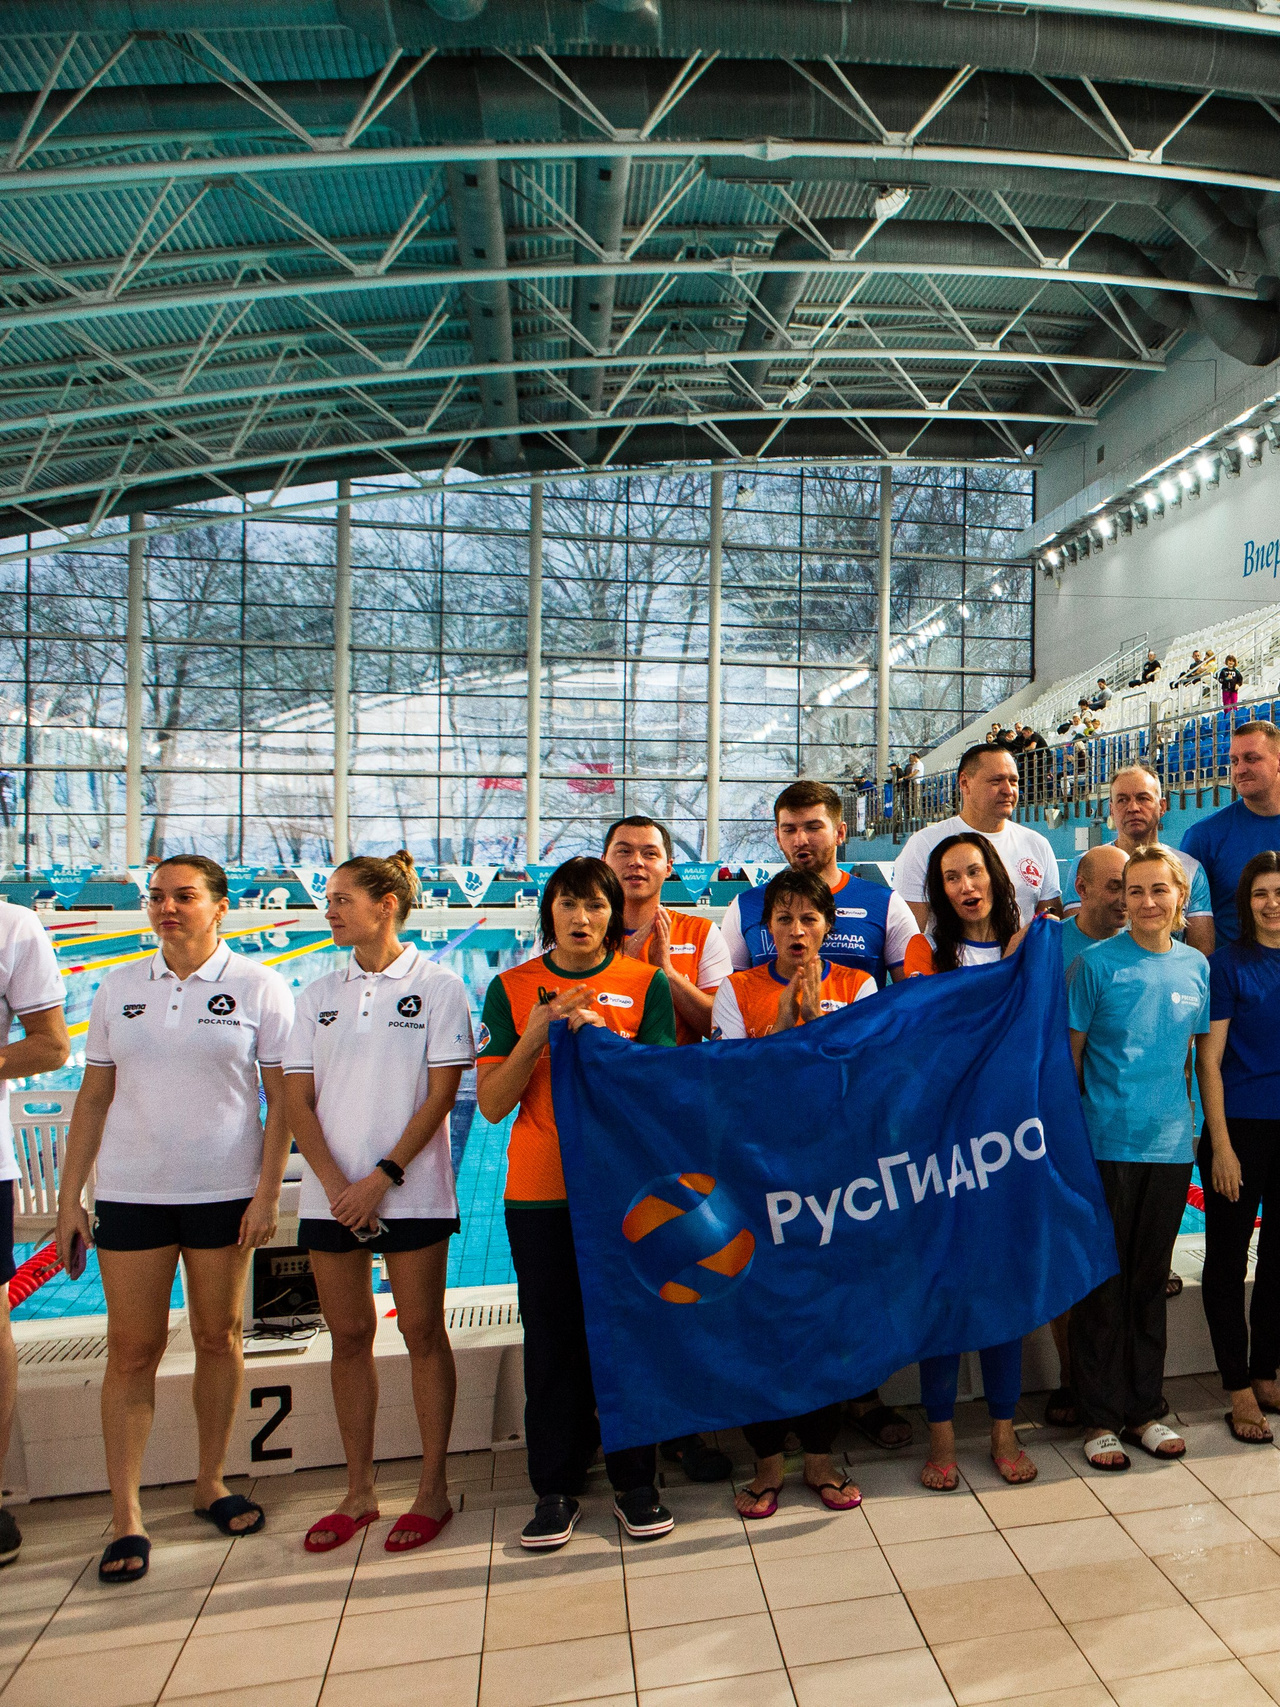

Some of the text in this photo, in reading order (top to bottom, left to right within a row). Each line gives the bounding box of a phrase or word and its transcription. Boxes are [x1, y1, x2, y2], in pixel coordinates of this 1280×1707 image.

[53, 868, 85, 877] MAD
[50, 876, 85, 885] WAVE
[826, 933, 865, 943] КИАДА
[123, 1003, 147, 1011] arena
[318, 1010, 339, 1018] arena
[197, 1018, 241, 1026] РОСАТОМ
[388, 1021, 426, 1030] РОСАТОМ
[765, 1117, 1047, 1247] РусГидро
[250, 1384, 293, 1463] 2
